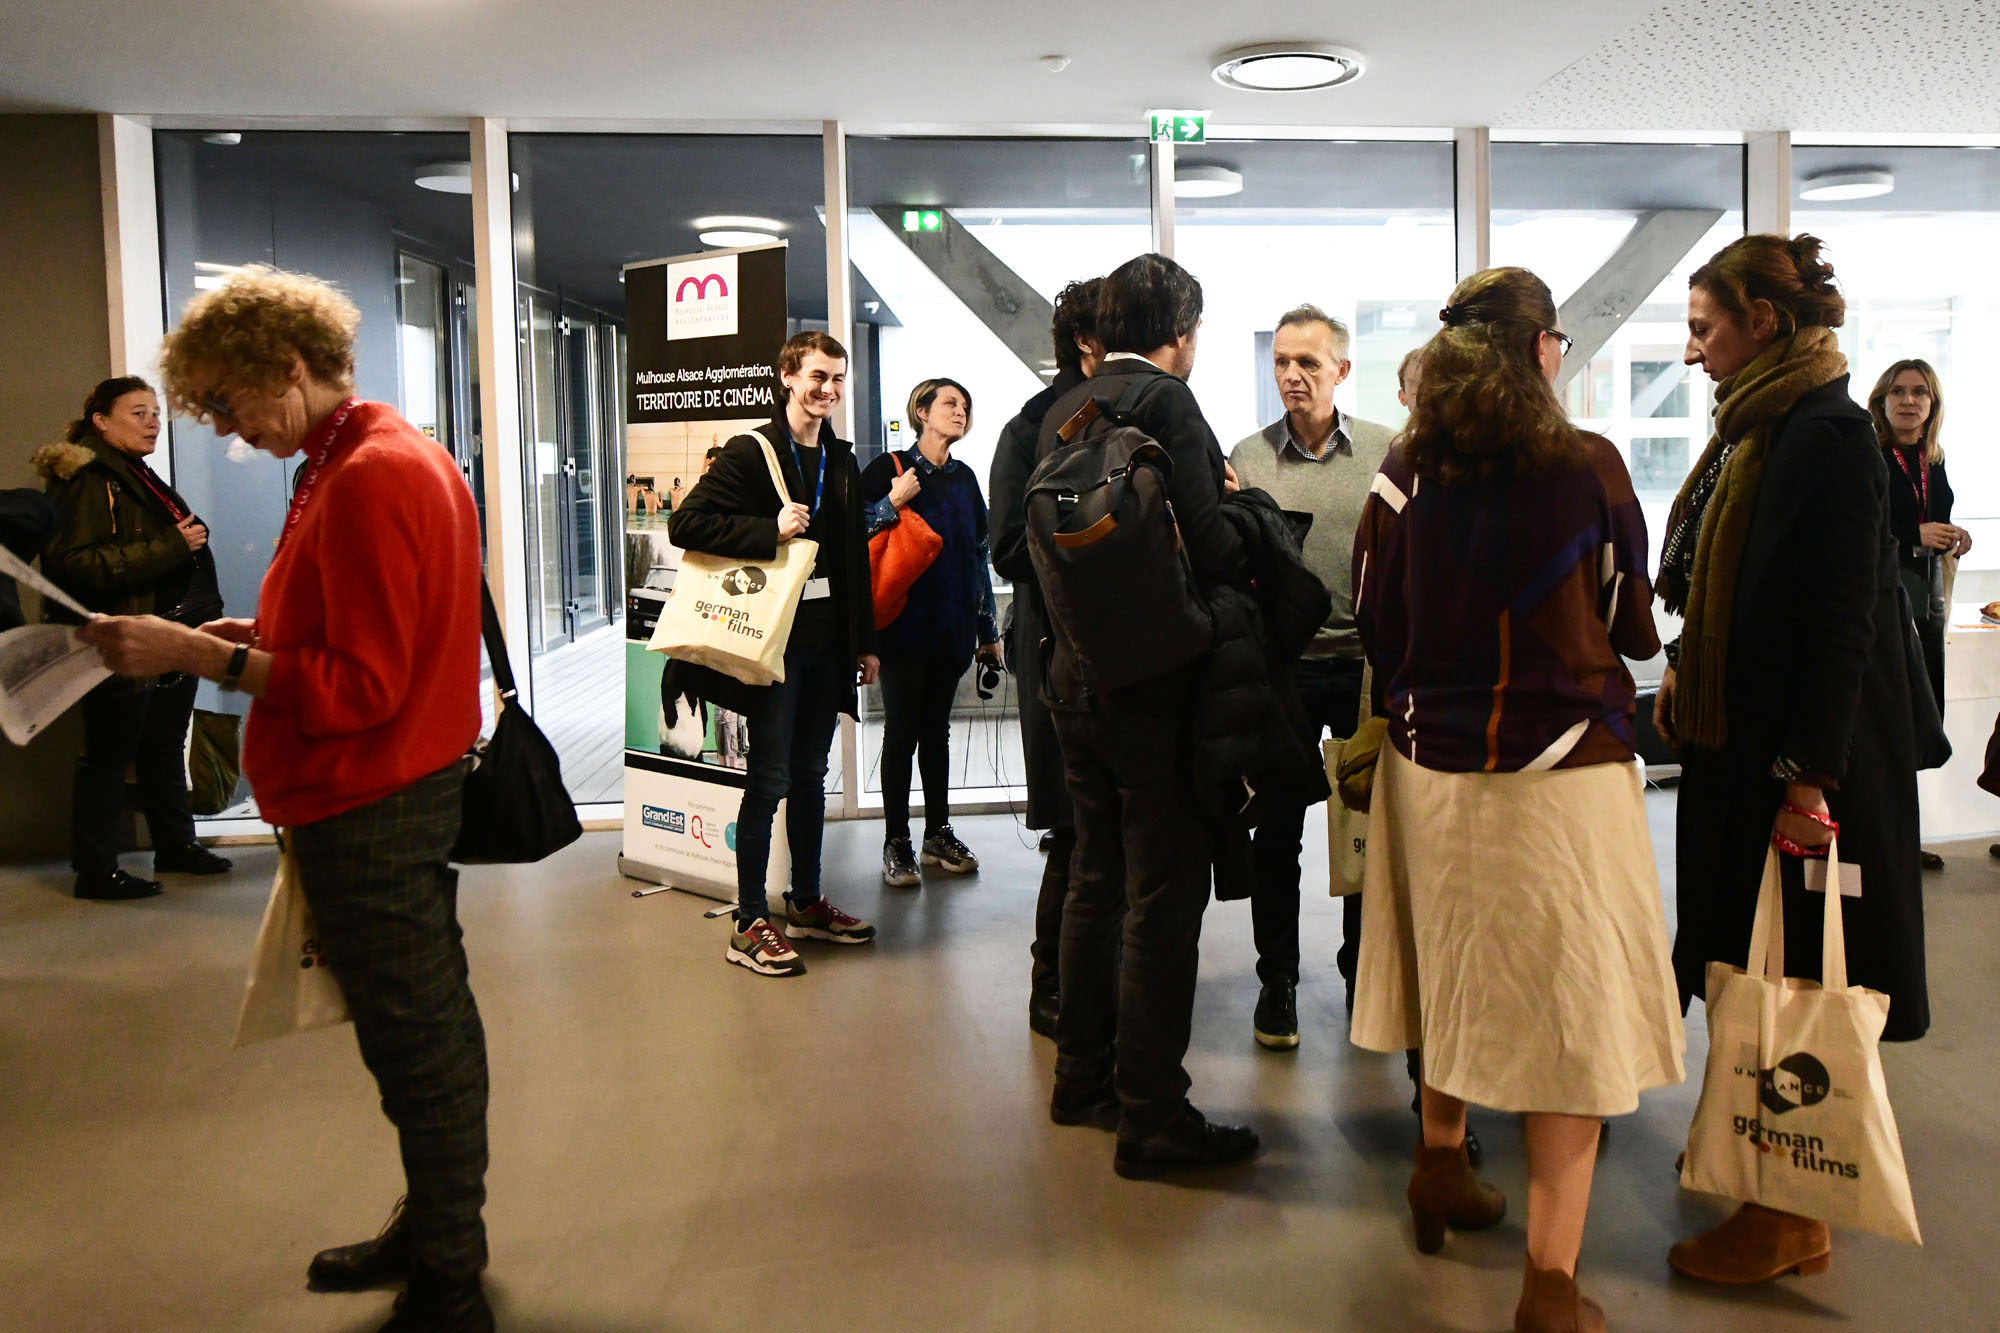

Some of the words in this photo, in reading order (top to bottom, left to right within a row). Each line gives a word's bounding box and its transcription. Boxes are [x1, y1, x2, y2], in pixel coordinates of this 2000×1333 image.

[636, 370, 675, 385] Mulhouse
[677, 368, 703, 382] Alsace
[705, 363, 774, 383] Agglomération,
[636, 390, 702, 411] TERRITOIRE
[704, 389, 721, 408] DE
[723, 384, 774, 407] CINÉMA
[707, 574, 763, 590] UNIFRANCE
[694, 600, 750, 622] german
[727, 618, 764, 639] films
[1791, 1148, 1859, 1179] films
